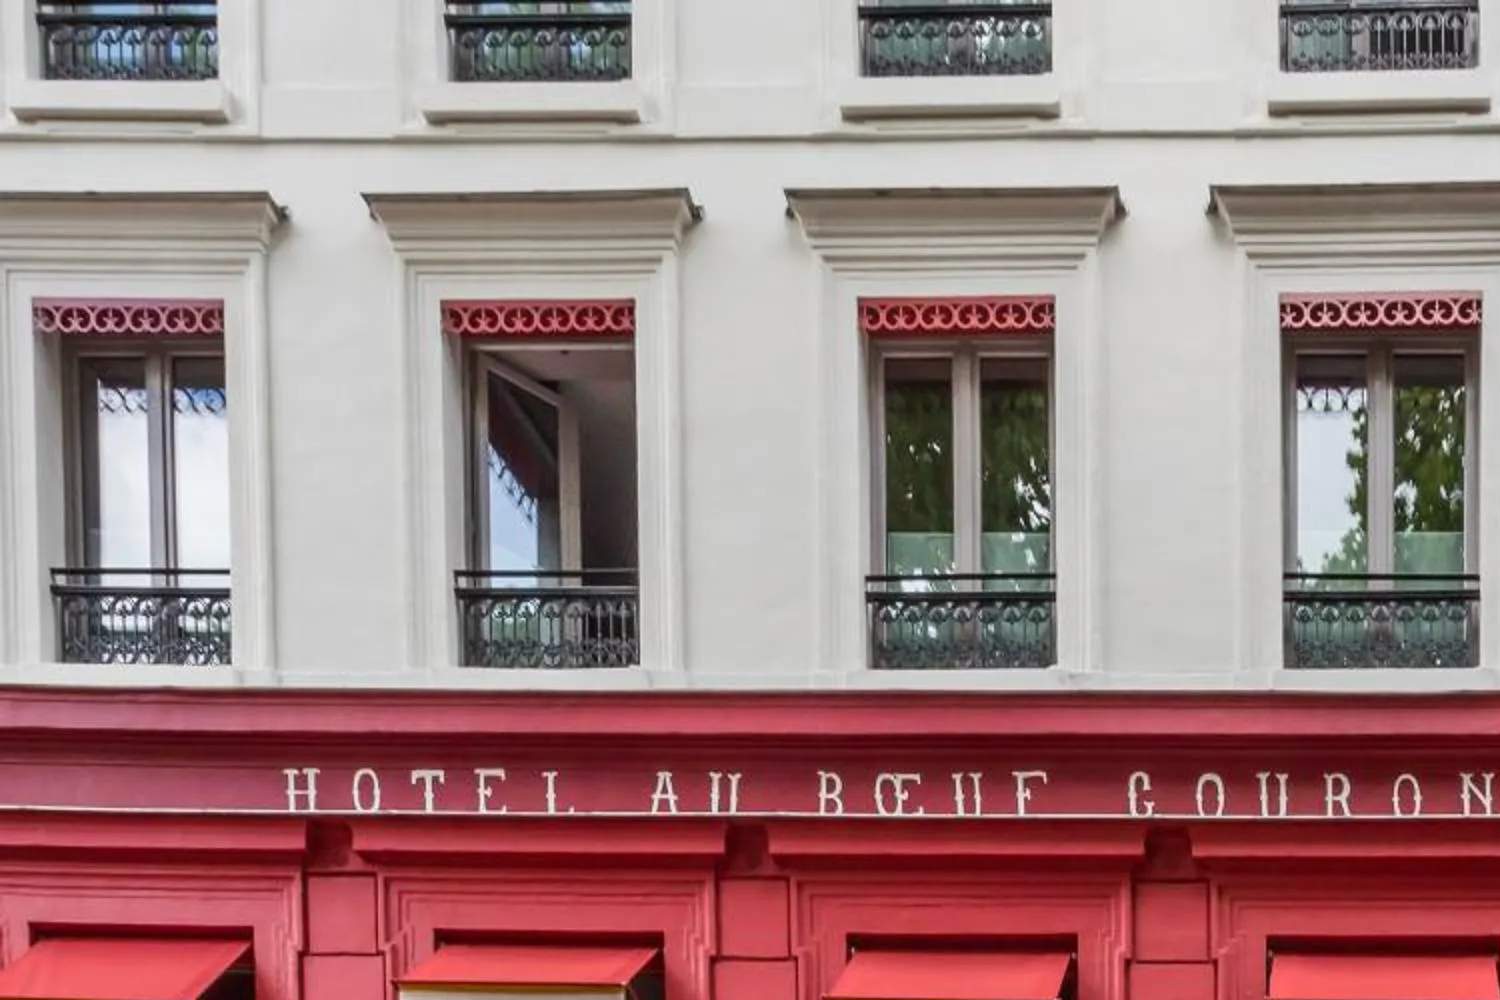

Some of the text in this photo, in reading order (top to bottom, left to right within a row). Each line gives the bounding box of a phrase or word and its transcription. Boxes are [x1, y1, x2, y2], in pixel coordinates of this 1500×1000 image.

[283, 767, 576, 814] HOTEL
[650, 770, 743, 815] AU
[817, 770, 1048, 816] BŒUF
